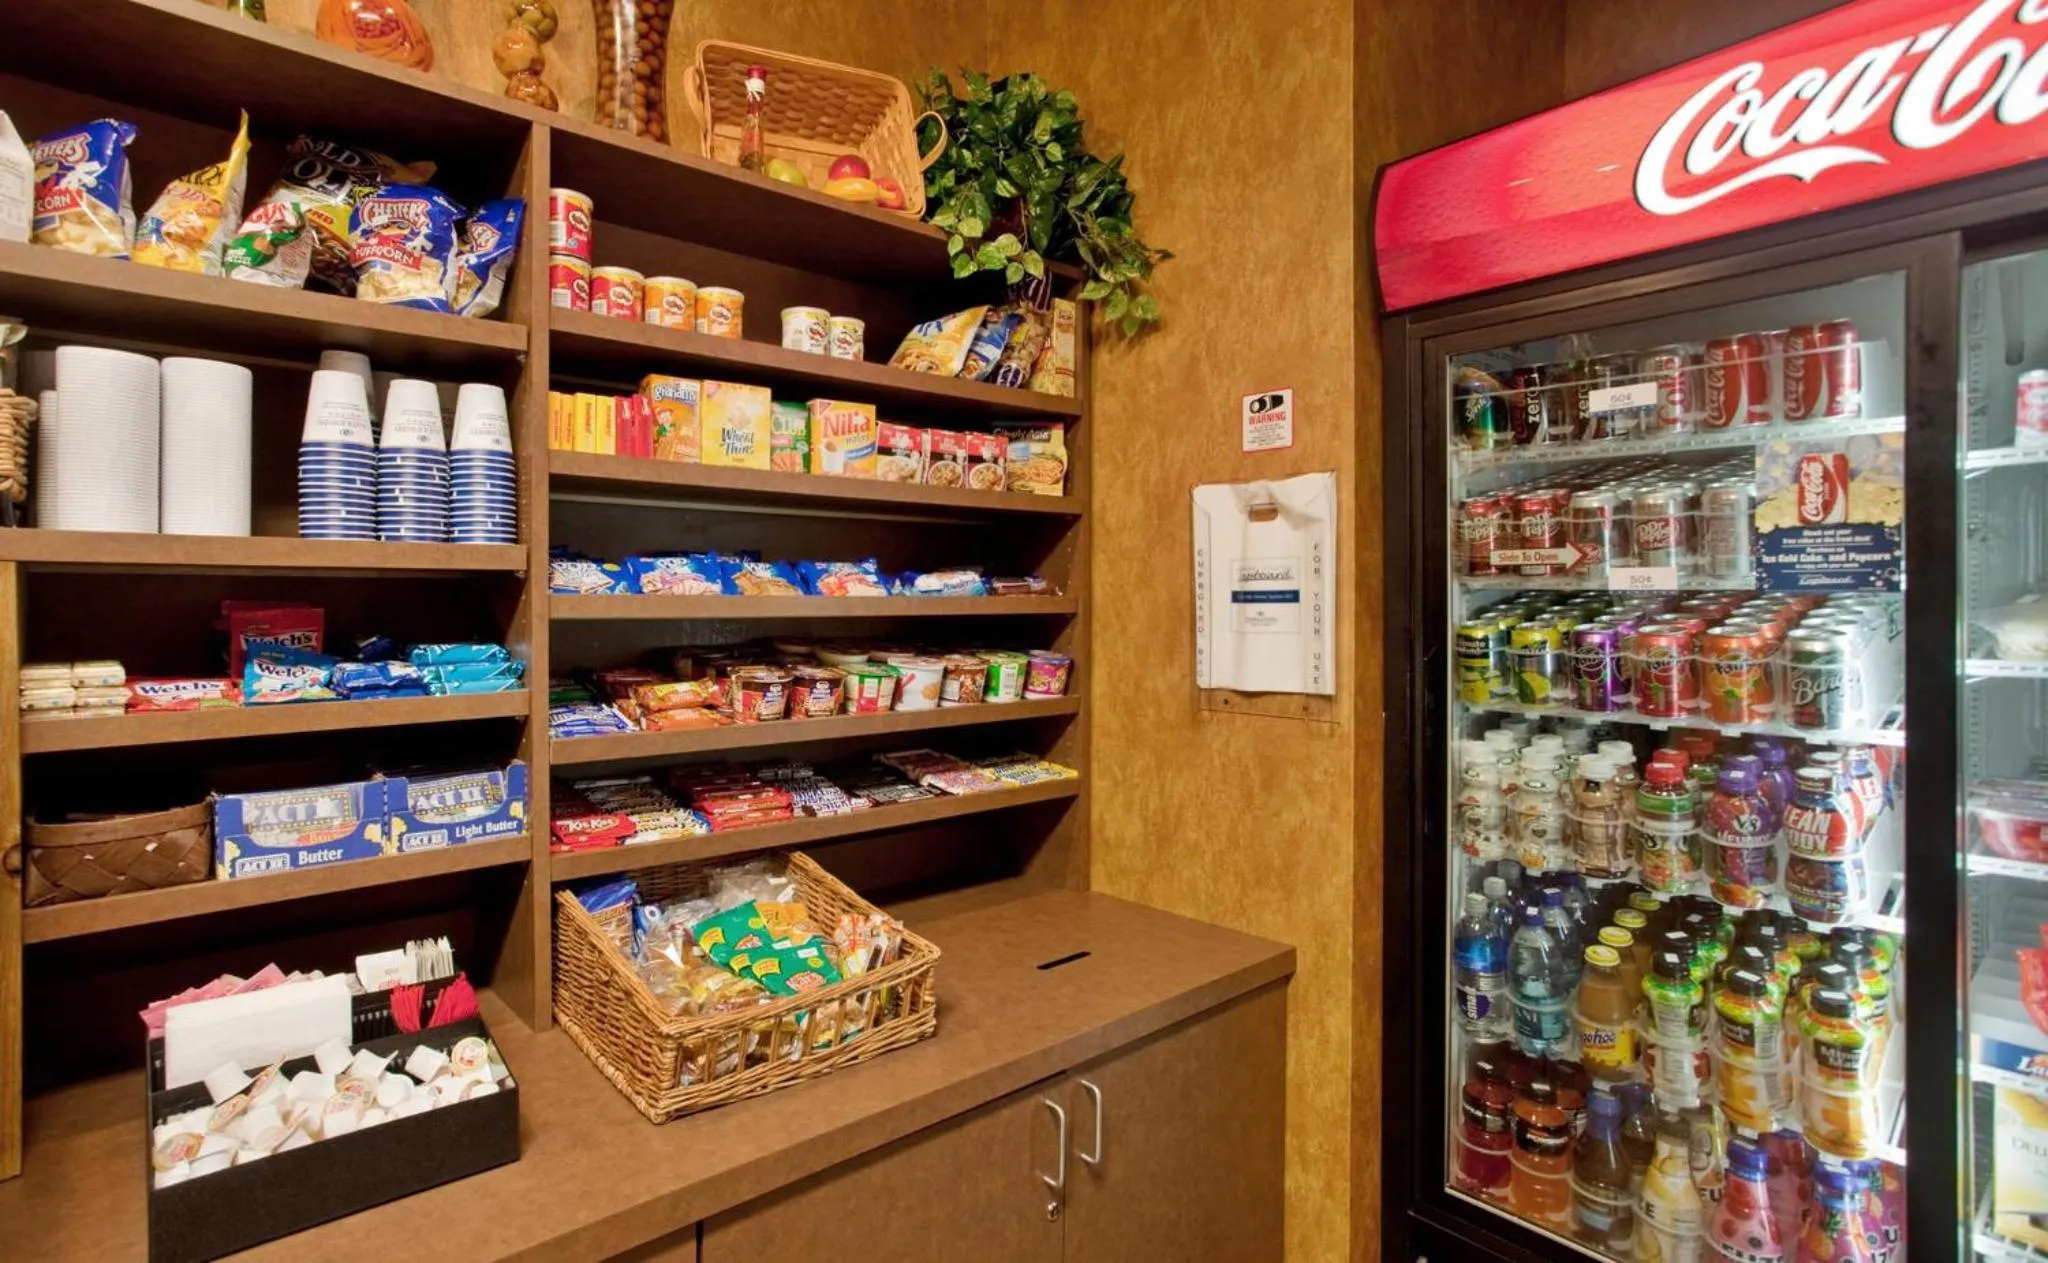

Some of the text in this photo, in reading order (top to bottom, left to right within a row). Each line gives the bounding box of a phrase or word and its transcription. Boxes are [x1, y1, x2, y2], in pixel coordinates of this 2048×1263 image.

[1249, 411, 1286, 425] WARNING
[139, 681, 219, 696] Welch's
[455, 820, 519, 838] Light Butter
[298, 849, 344, 865] Butter
